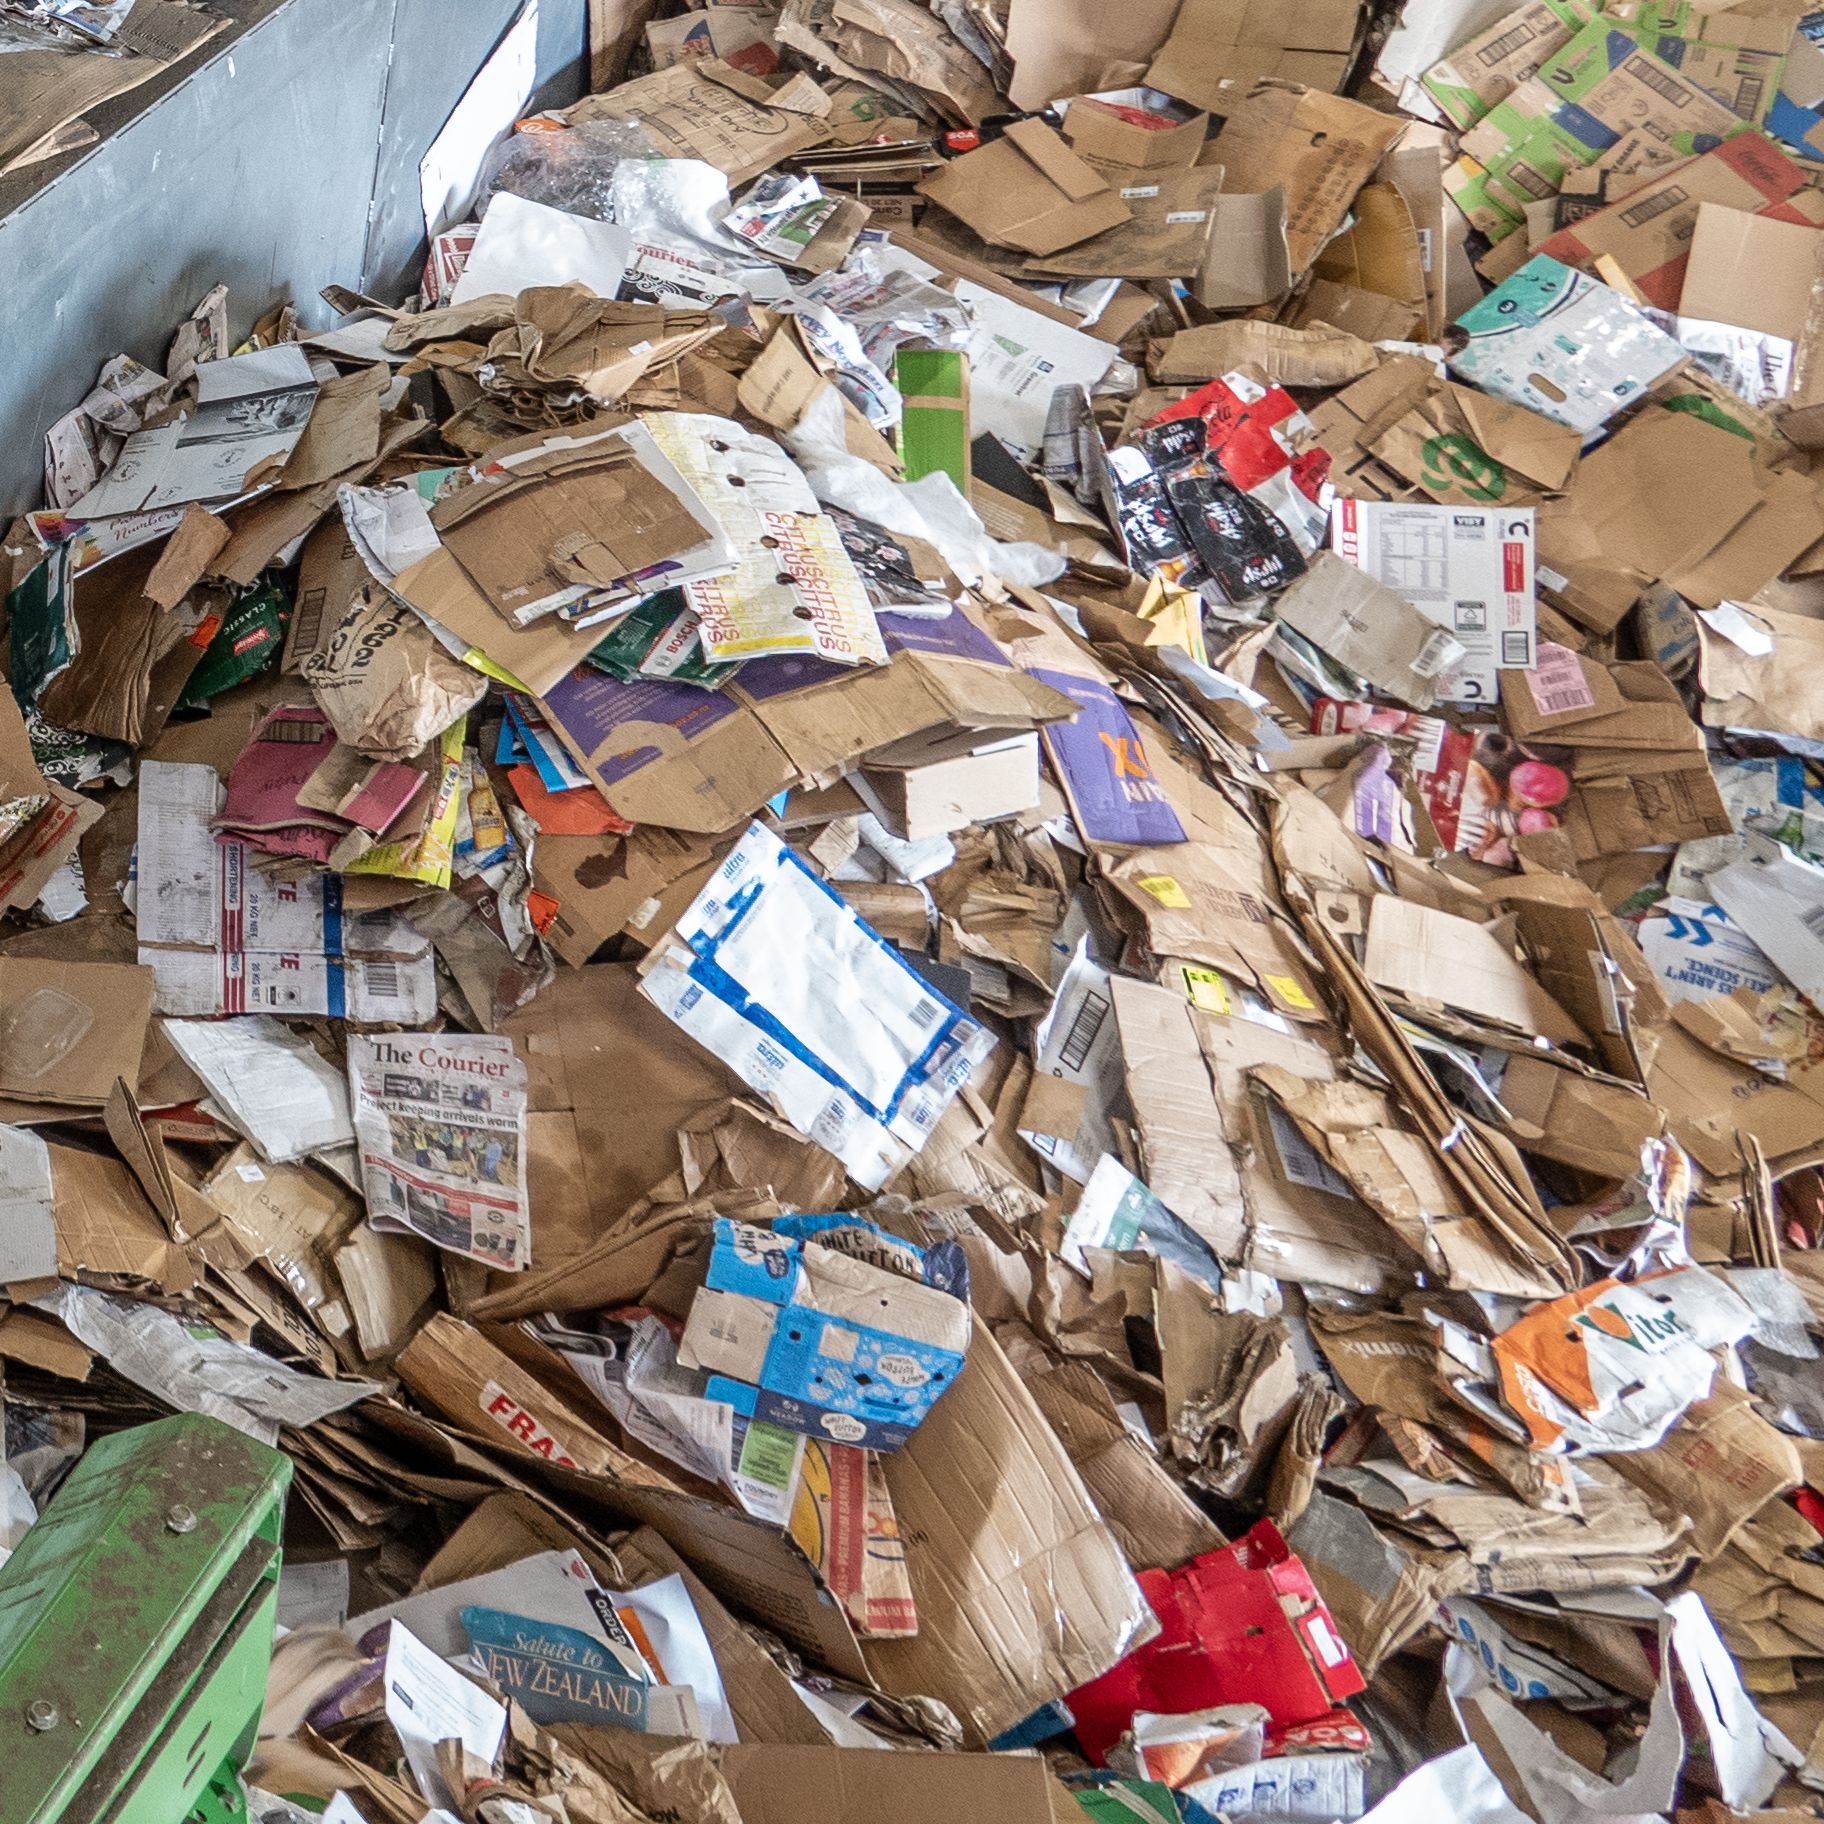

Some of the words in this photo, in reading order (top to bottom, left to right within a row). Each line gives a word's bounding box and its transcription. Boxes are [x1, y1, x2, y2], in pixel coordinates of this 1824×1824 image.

[115, 508, 180, 541] Numbers
[222, 602, 268, 636] CLASSIC
[667, 619, 701, 655] BOSCH
[722, 851, 747, 880] ultra
[1664, 965, 1716, 989] AREN'T
[1684, 957, 1741, 985] SCIENCE.
[372, 1042, 413, 1065] The
[418, 1048, 511, 1077] Courier
[359, 1093, 397, 1113] Project
[399, 1100, 441, 1121] keeping
[443, 1110, 485, 1125] arrivals
[487, 1115, 519, 1129] warm
[838, 1462, 853, 1513] BANANAS
[838, 1512, 853, 1565] PREMIUM
[513, 1631, 577, 1663] Salute
[582, 1647, 604, 1669] to
[472, 1643, 530, 1688] NEW
[529, 1657, 643, 1717] ZEALAND
